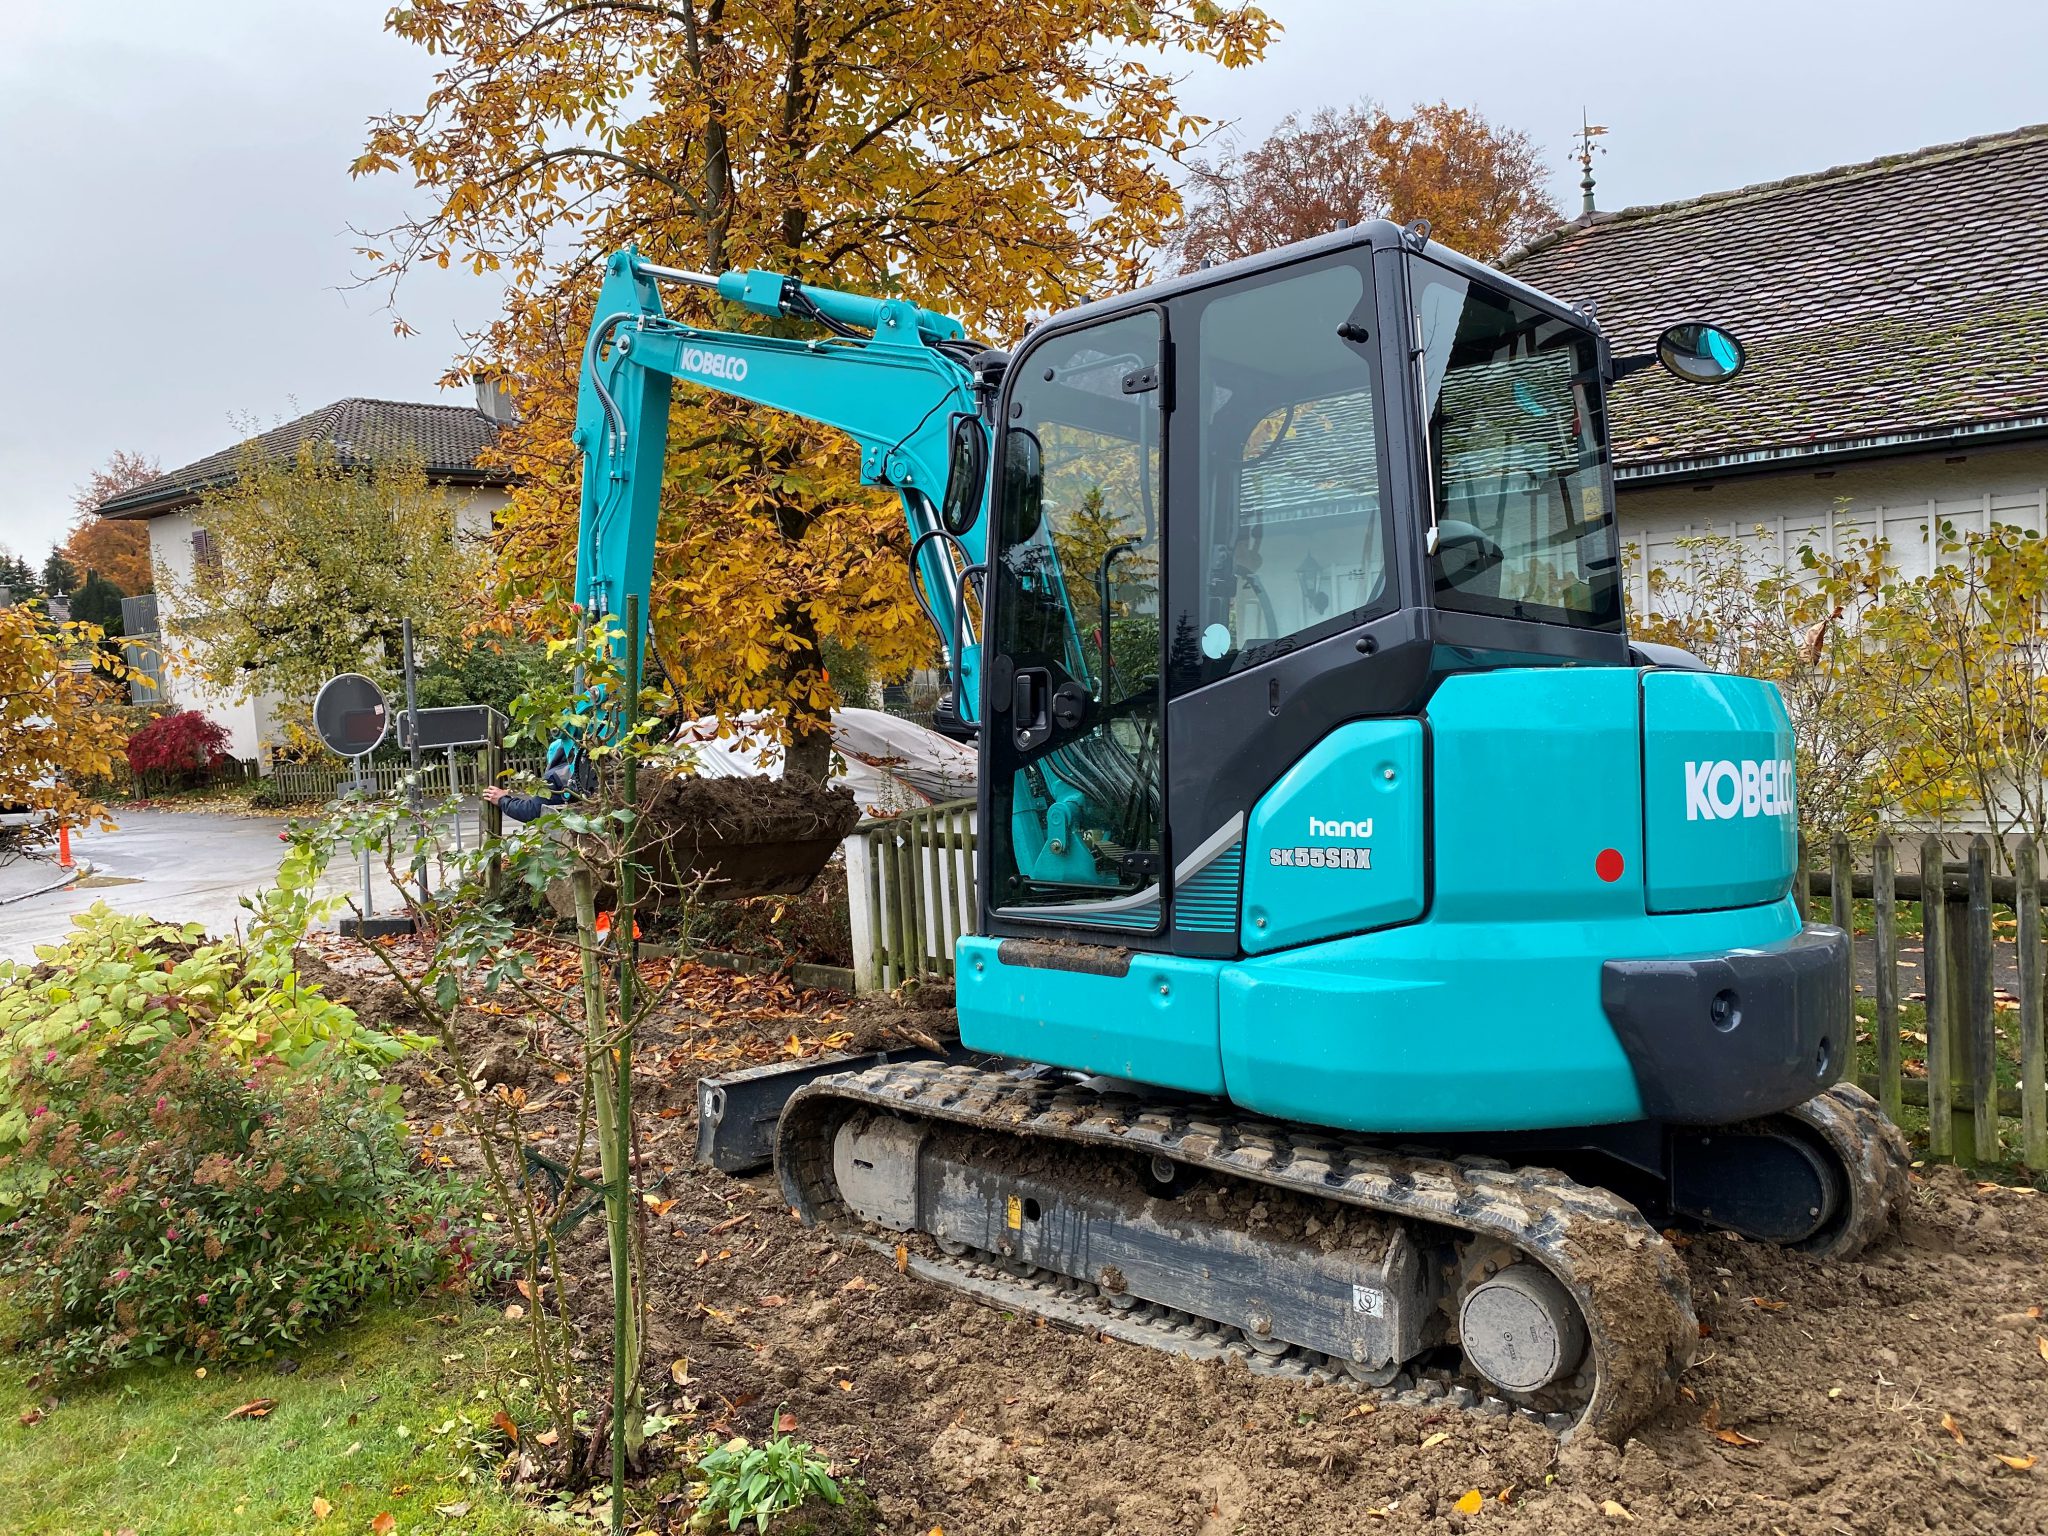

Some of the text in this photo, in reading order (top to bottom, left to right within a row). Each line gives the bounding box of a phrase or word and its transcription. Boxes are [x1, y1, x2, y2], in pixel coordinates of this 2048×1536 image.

[681, 347, 748, 382] KOBELCO
[1684, 760, 1793, 820] KOBELCO
[1309, 816, 1373, 838] hand
[1269, 847, 1372, 870] SK55SRX
